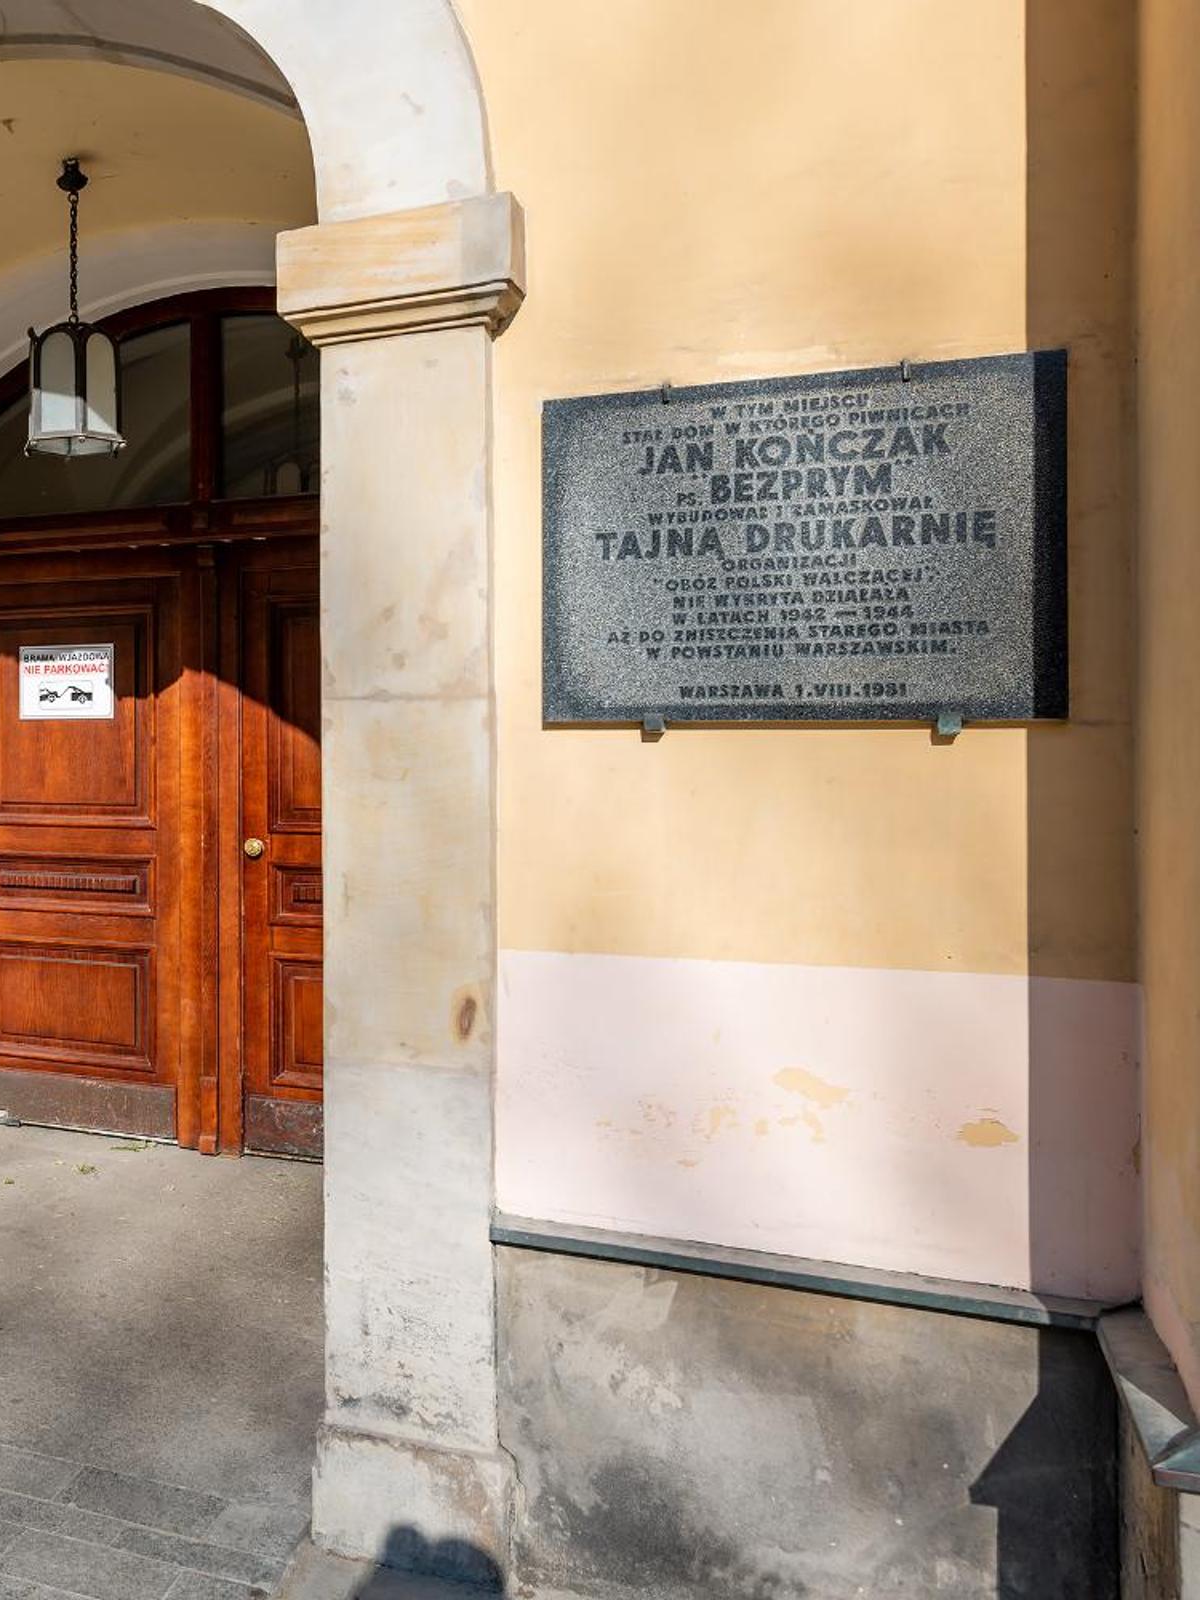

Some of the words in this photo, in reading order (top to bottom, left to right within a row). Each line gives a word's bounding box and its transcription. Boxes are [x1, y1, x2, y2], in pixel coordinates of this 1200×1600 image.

[711, 406, 727, 419] W
[734, 402, 773, 417] TYM
[783, 393, 870, 412] MIEJSCU
[622, 430, 663, 444] STAŁ
[672, 424, 715, 440] DOM
[724, 422, 742, 435] W
[749, 412, 841, 433] KTÓREGO
[848, 402, 970, 425] PIWNICACH
[639, 441, 714, 476] JAN
[735, 422, 951, 470] KOŃCZAK
[648, 506, 769, 526] WYBUDOWAŁ
[792, 496, 933, 517] ZAMASKOWAŁ
[595, 526, 725, 562] TAJNĄ
[745, 510, 997, 554] DRUKARNIĘ
[721, 553, 857, 573] ORGANIZACJI
[725, 573, 794, 590] POLSKI
[673, 595, 705, 609] NIE
[712, 591, 805, 608] WYKRYTA
[812, 588, 910, 604] DZIAŁAŁA
[673, 613, 688, 625] W
[697, 610, 769, 626] LATACH
[781, 607, 827, 622] 1942
[863, 605, 915, 621] 1944
[607, 627, 631, 645] AŻ
[638, 630, 666, 644] DO
[674, 624, 800, 643] ZNISZCZENIA
[809, 622, 898, 639] STAREGO
[909, 619, 990, 637] MIASTA
[23, 653, 55, 663] BRAMA
[646, 647, 661, 661] W
[672, 642, 786, 660] POWSTANIU
[795, 638, 956, 657] WARSZAWSKIM.
[24, 664, 41, 676] NIE
[679, 684, 784, 700] WARSZAWA
